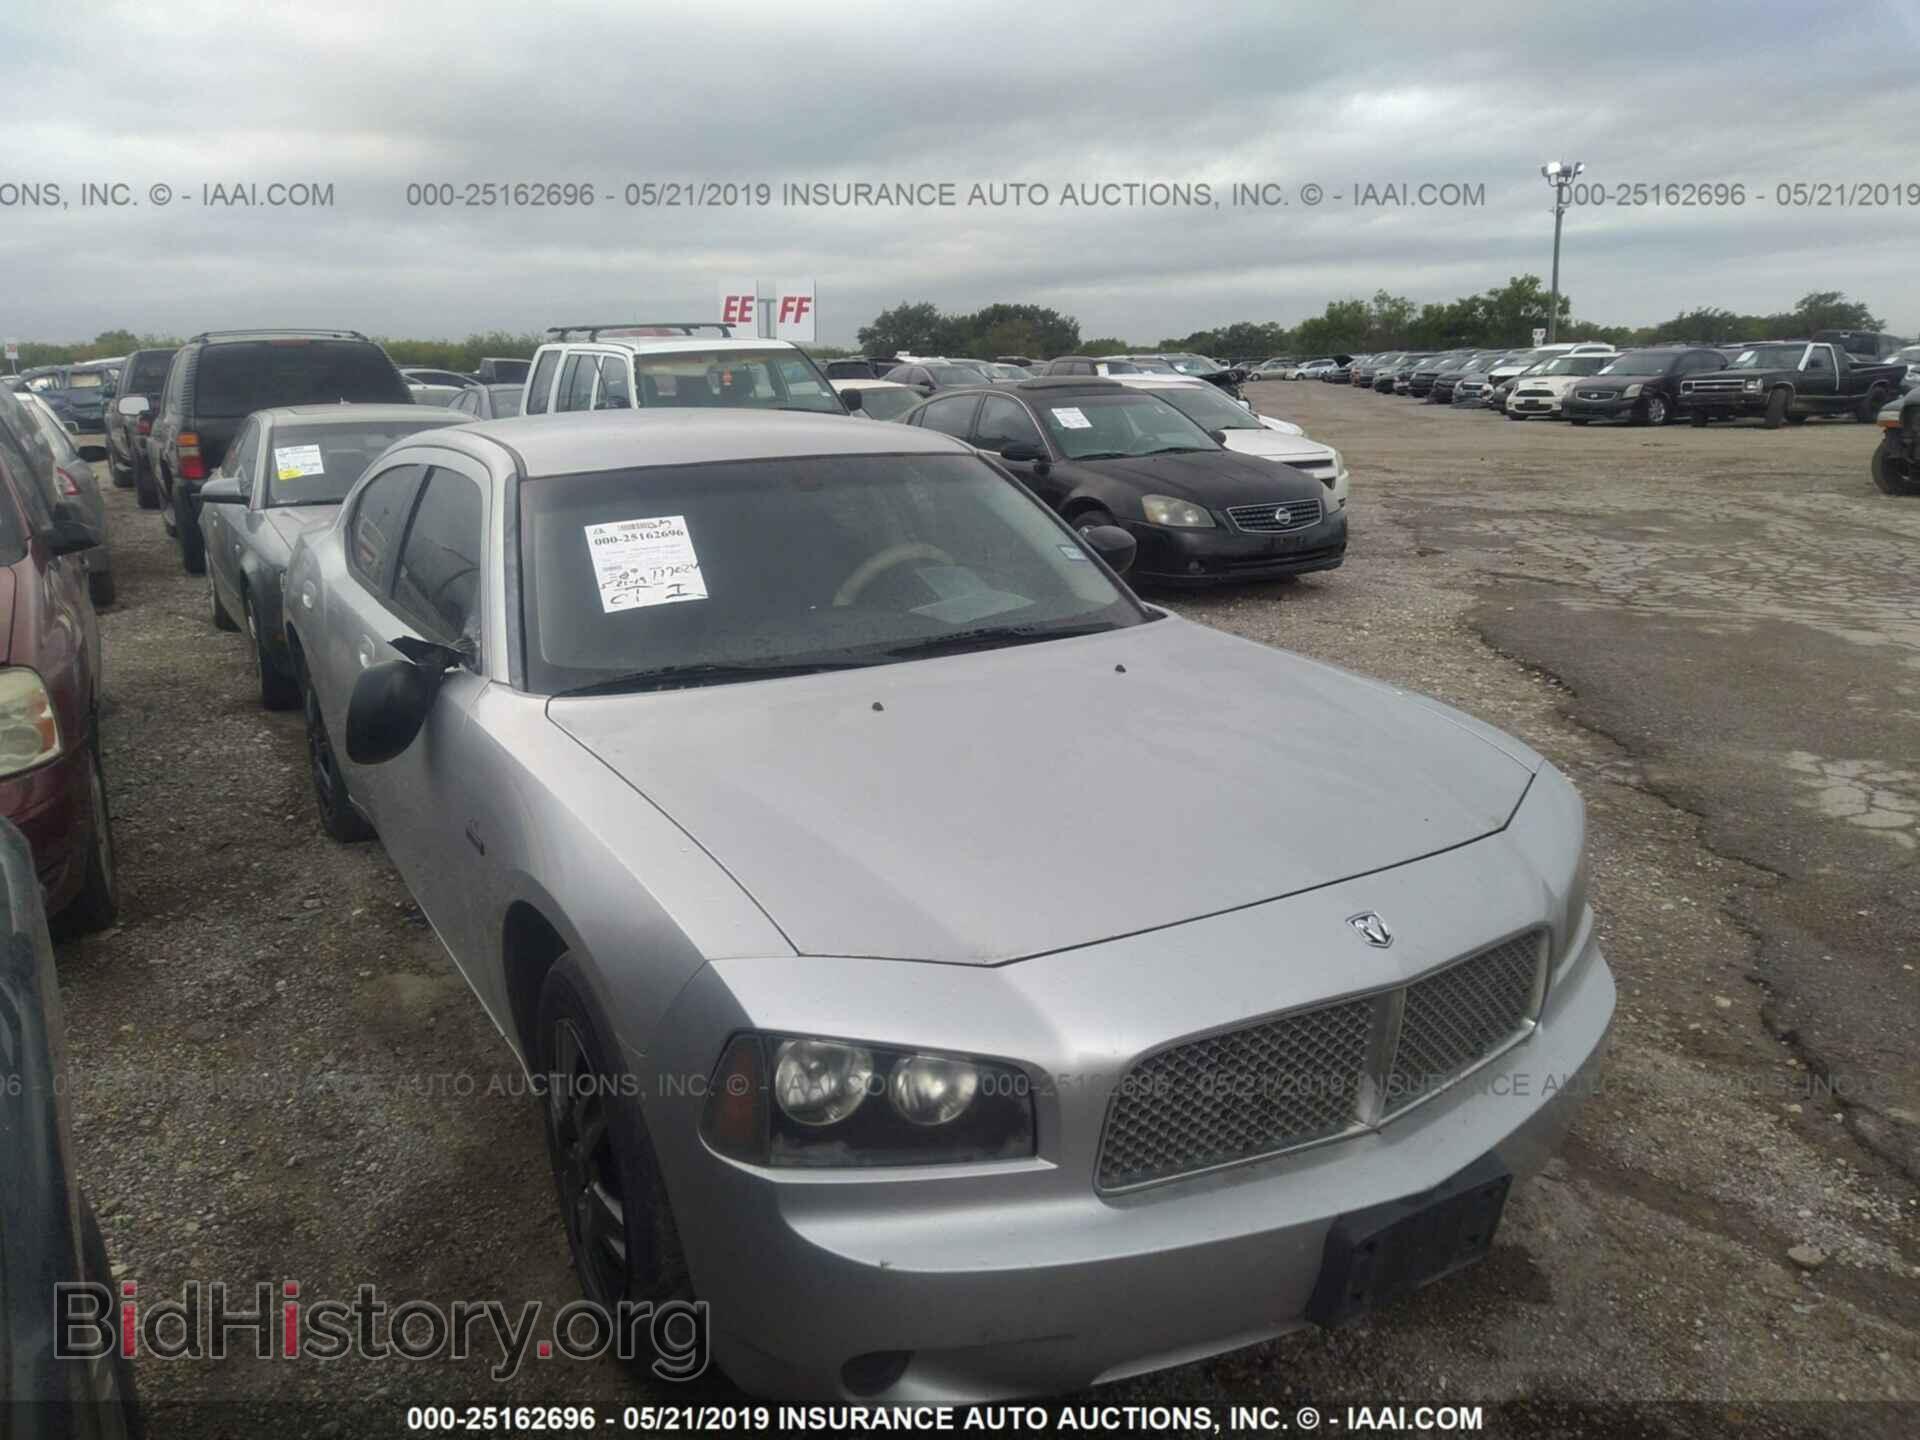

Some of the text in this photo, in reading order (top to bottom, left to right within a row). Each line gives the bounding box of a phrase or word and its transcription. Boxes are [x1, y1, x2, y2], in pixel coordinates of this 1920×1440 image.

[723, 295, 755, 323] EE
[778, 296, 812, 324] FF
[595, 529, 684, 545] 000-25162696
